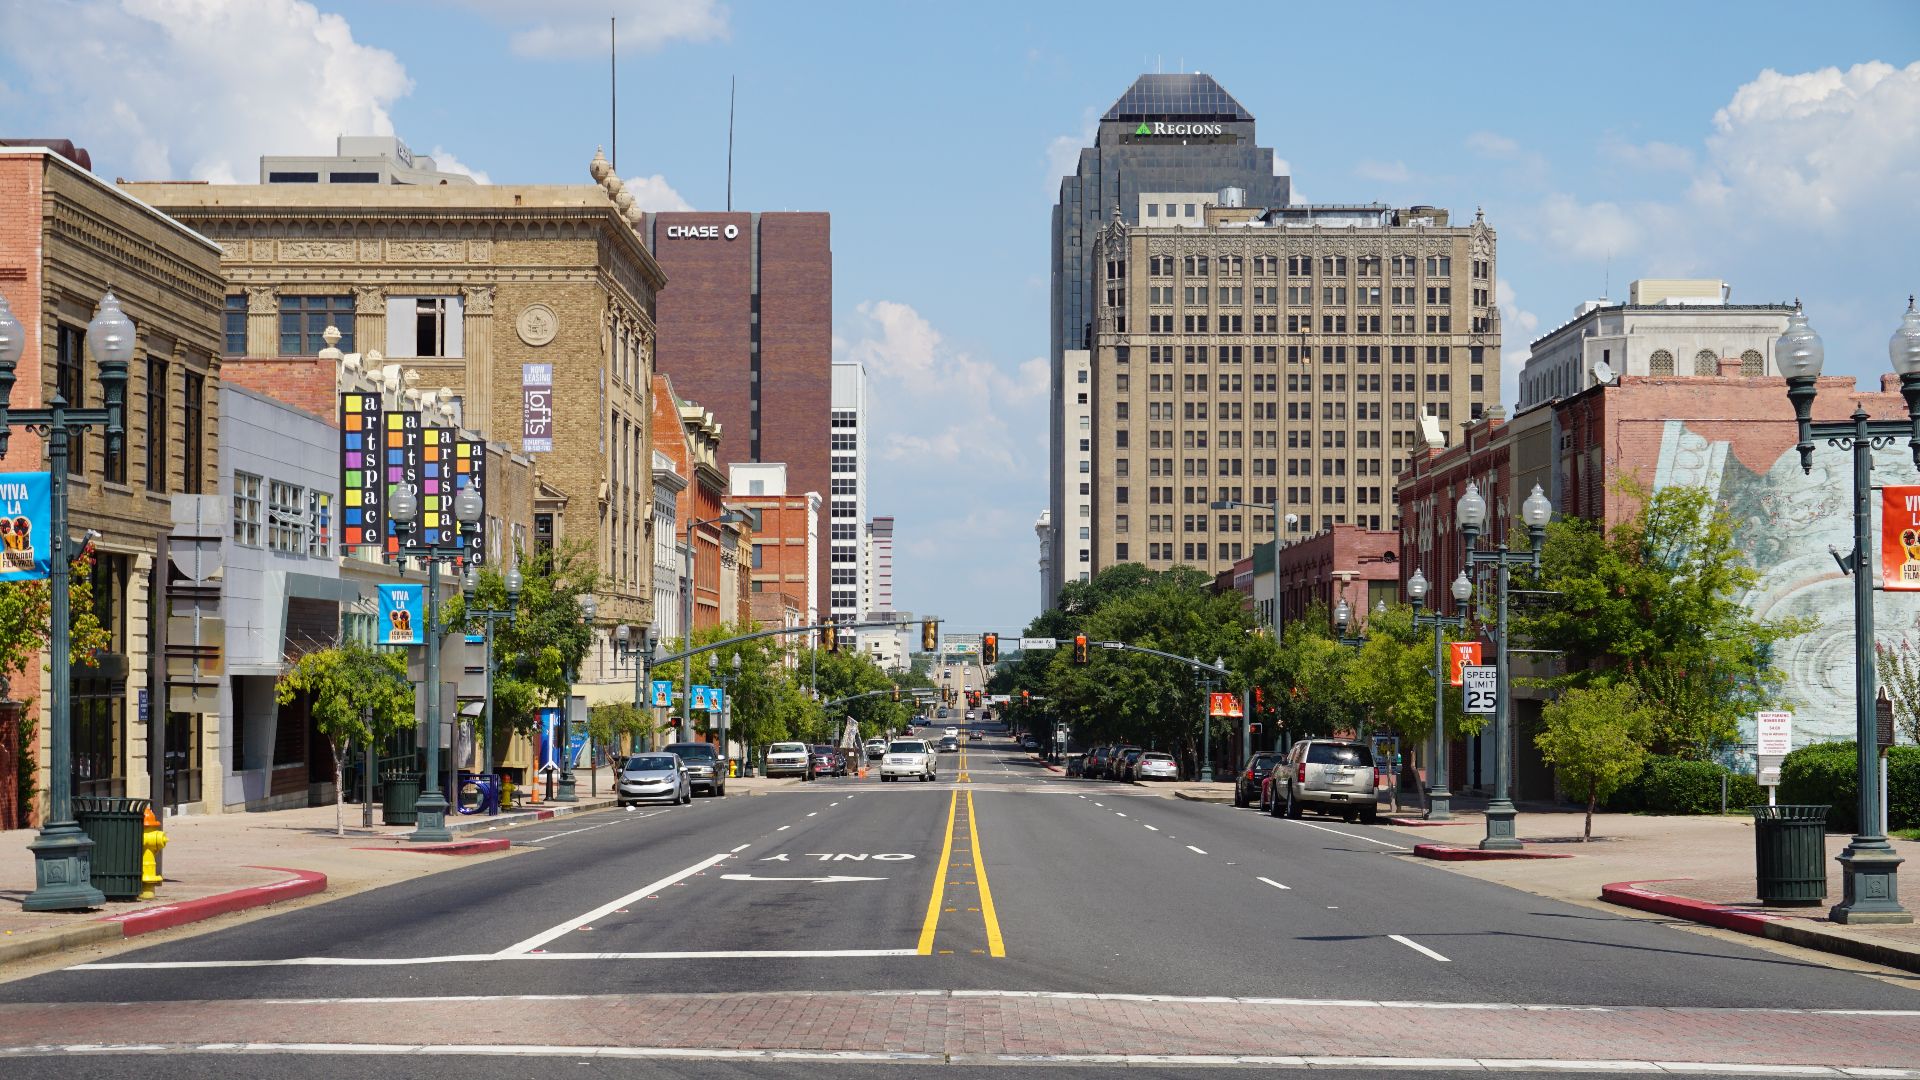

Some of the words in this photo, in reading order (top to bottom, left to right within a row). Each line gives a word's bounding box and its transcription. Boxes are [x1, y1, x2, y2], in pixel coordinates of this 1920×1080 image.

[1154, 122, 1222, 135] REGIONS
[667, 226, 719, 238] CHASE
[530, 366, 545, 374] NOW
[525, 373, 551, 382] LEASING
[529, 389, 552, 435] lofts
[364, 397, 378, 542] artspace
[405, 415, 418, 546] artspce
[440, 431, 453, 542] artspac
[0, 483, 29, 500] VIVA
[7, 500, 22, 515] LA
[472, 444, 483, 564] artace
[392, 590, 409, 600] VIVA
[396, 600, 404, 609] LA
[1466, 671, 1497, 679] SPEED
[1468, 680, 1495, 689] LIMIT
[1467, 691, 1497, 709] 25
[760, 853, 916, 862] ONLY
